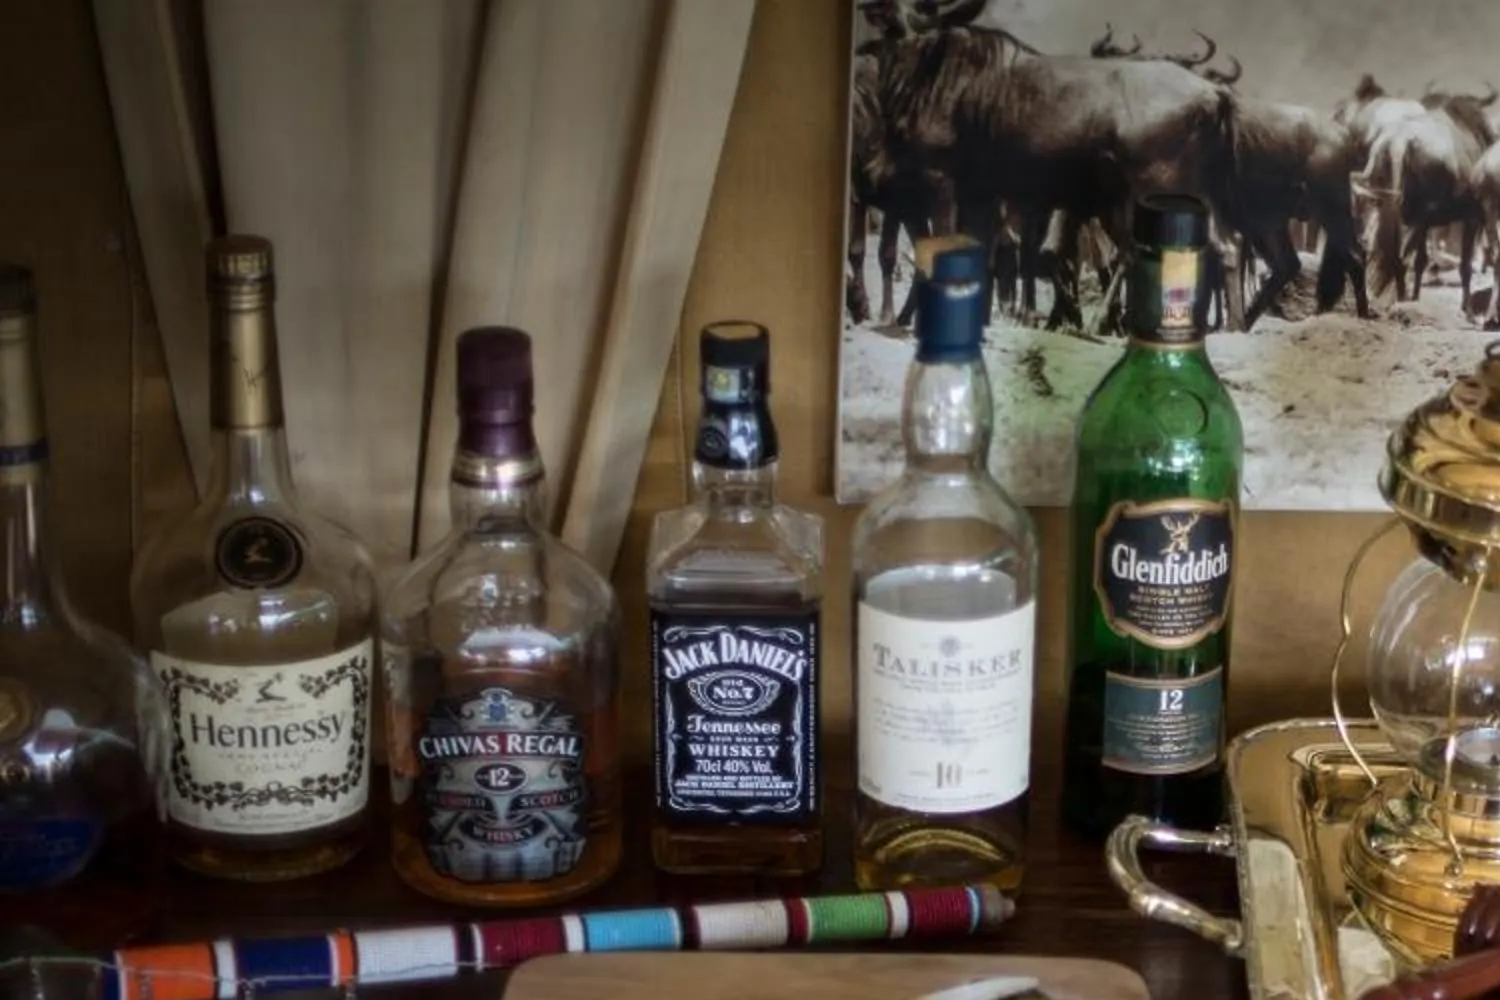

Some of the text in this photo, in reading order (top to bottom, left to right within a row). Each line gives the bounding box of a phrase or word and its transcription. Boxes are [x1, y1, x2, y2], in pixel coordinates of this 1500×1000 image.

[1111, 543, 1227, 584] Glenfiddich
[663, 641, 719, 679] JACK
[873, 643, 1023, 677] TALISKER
[1160, 690, 1183, 710] 12
[189, 710, 347, 748] Hennessy
[686, 714, 782, 735] Tennessee
[419, 733, 581, 759] CHIVAS REGAL
[689, 744, 781, 758] WHISKEY
[488, 768, 511, 787] 12
[724, 760, 750, 774] 40%
[936, 762, 963, 789] 10
